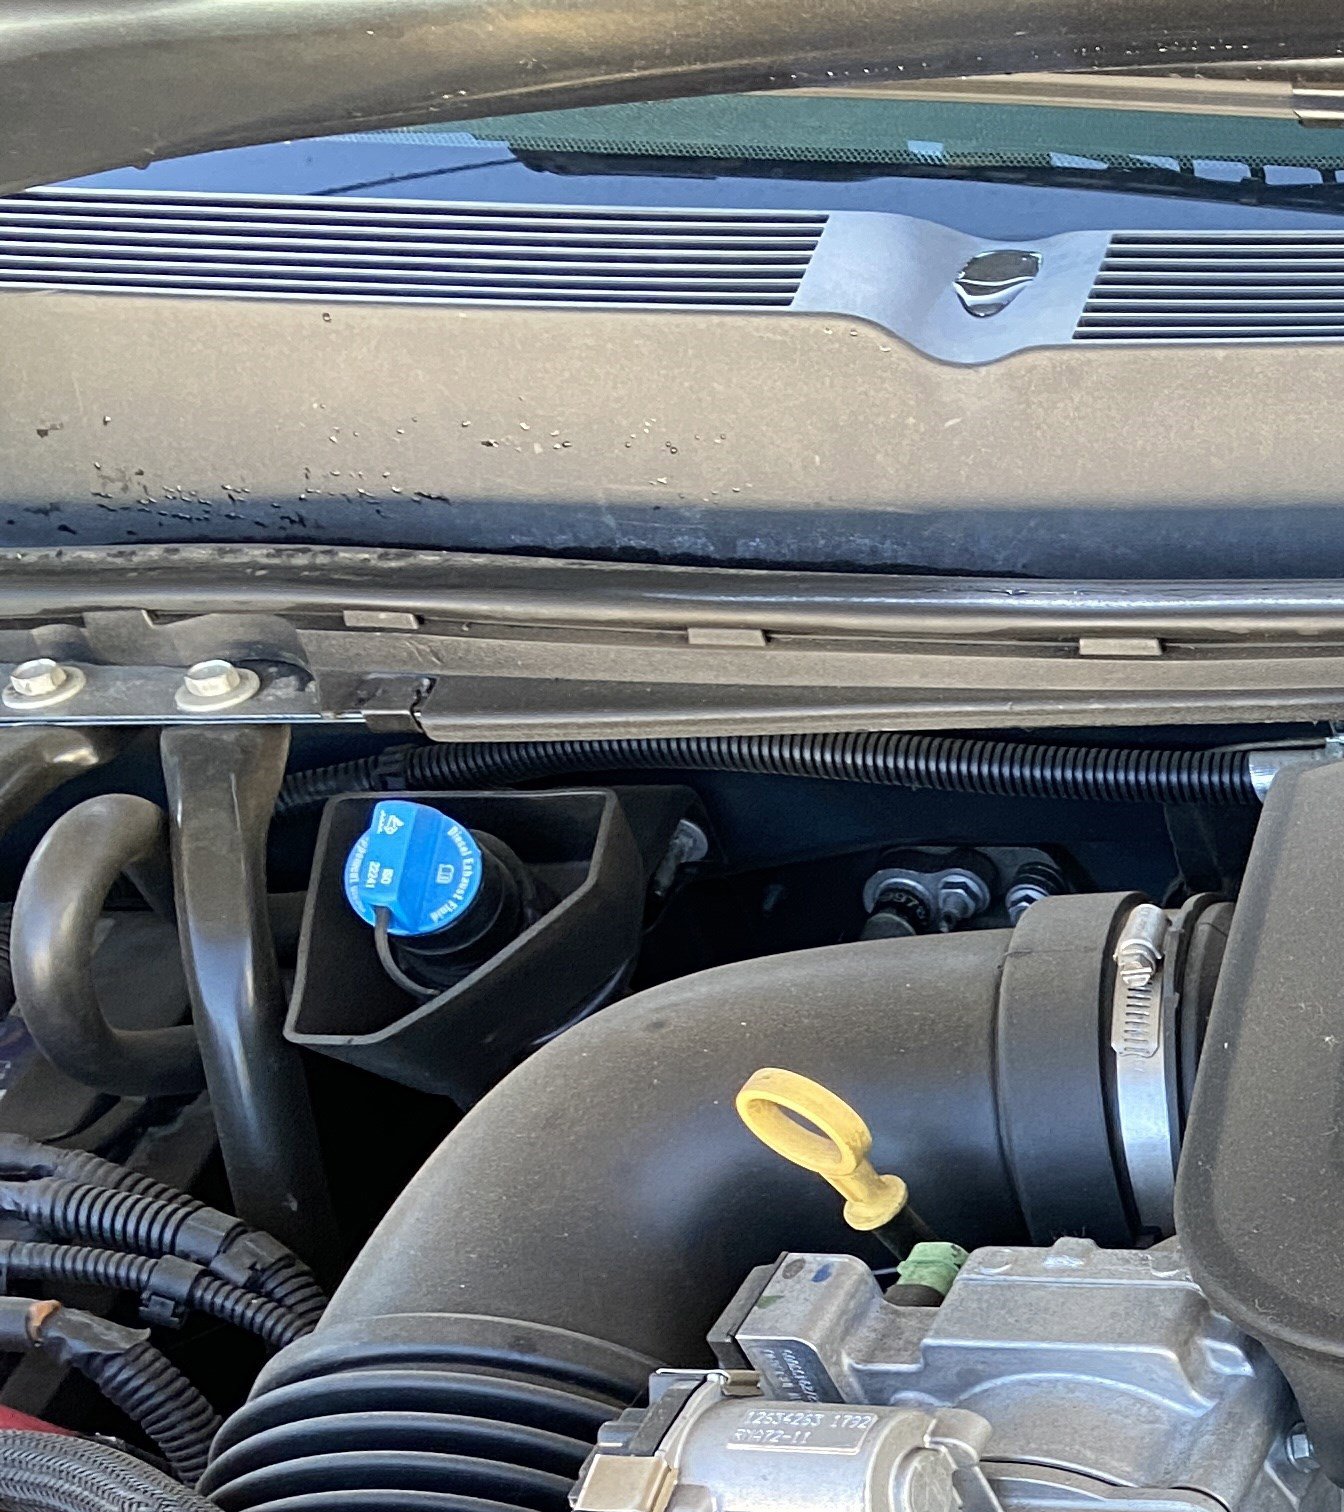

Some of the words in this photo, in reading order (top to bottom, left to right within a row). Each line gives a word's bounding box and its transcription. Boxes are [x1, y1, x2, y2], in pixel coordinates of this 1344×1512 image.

[447, 825, 473, 857] Diesel
[453, 857, 474, 901] Exhaust
[429, 900, 458, 923] Fluid
